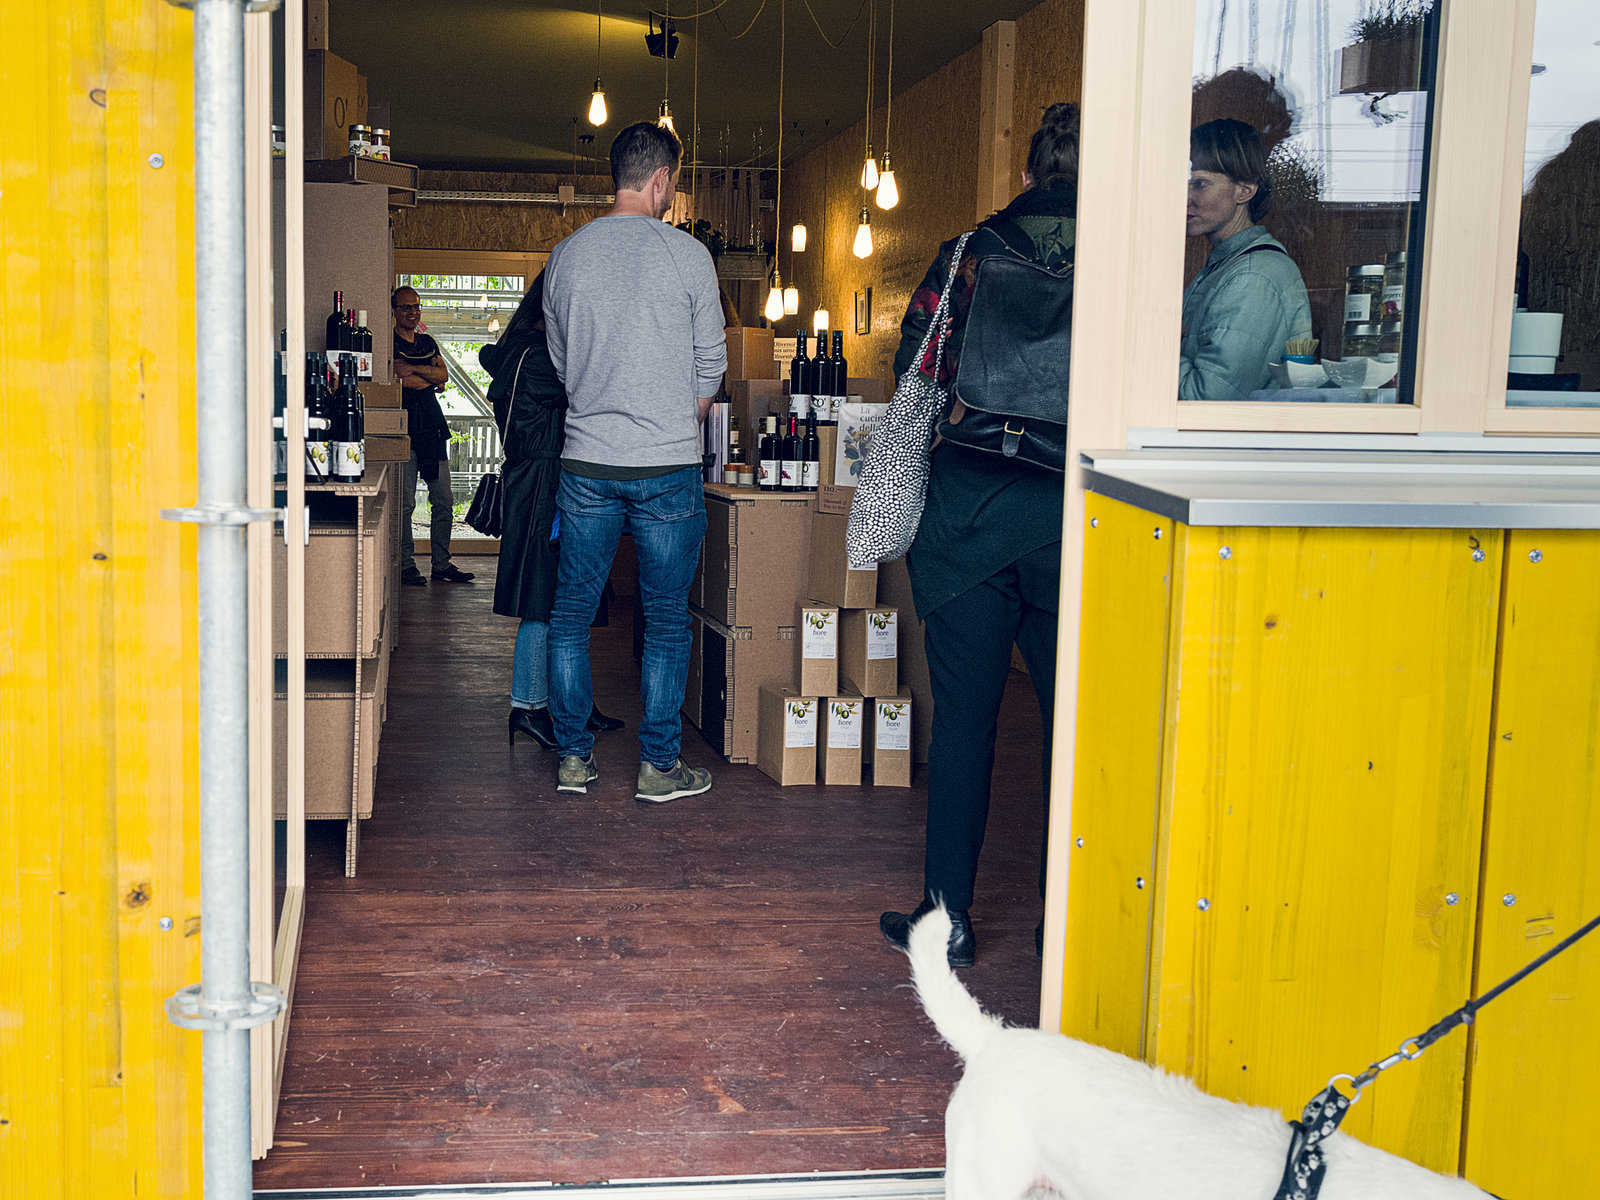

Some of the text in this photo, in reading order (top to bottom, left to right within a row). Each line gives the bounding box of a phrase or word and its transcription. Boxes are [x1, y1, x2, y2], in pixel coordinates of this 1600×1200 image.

[860, 406, 870, 414] La
[860, 414, 884, 422] cucin
[875, 629, 890, 637] fiore
[885, 720, 901, 728] fiore
